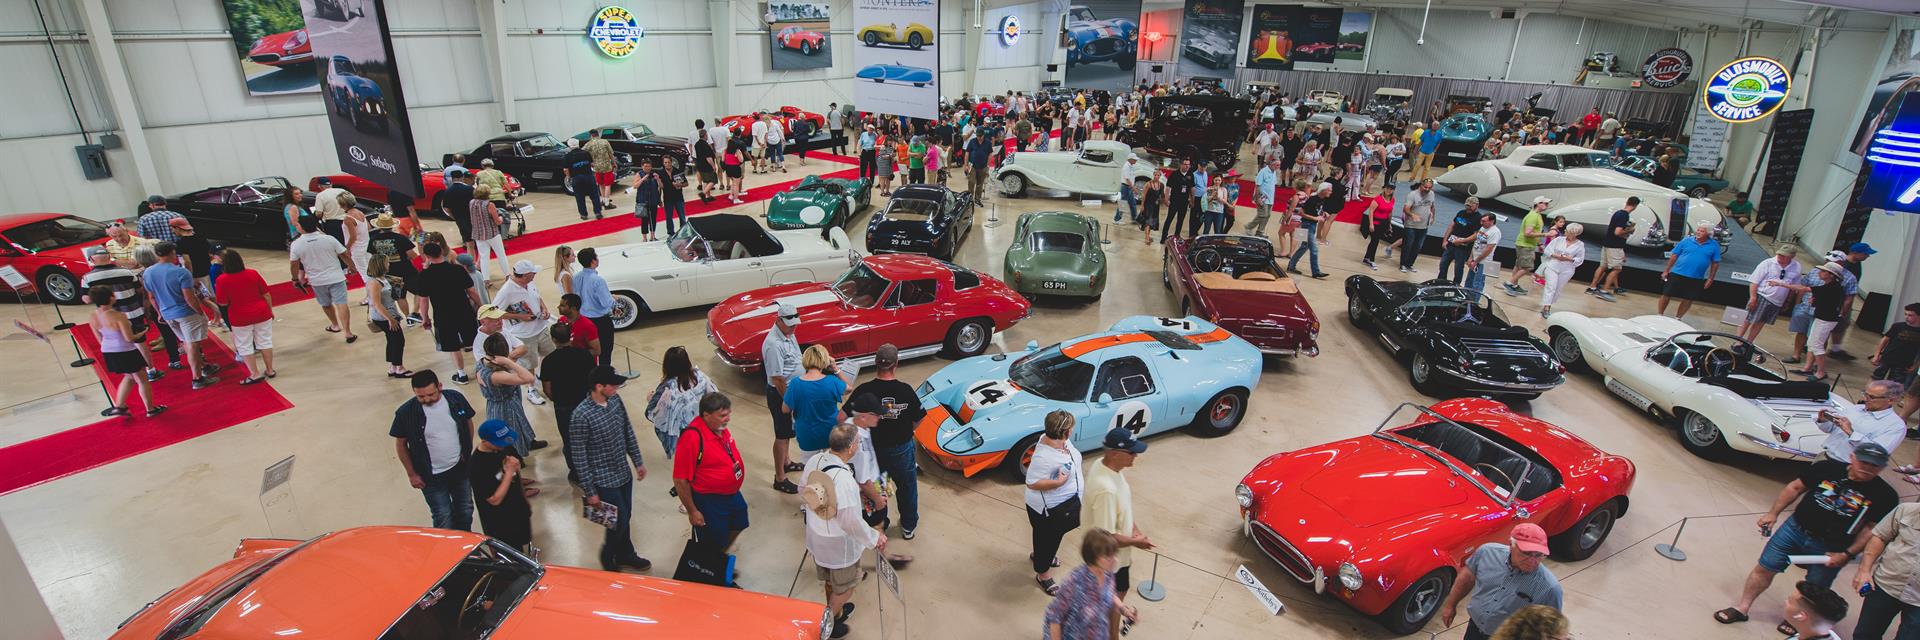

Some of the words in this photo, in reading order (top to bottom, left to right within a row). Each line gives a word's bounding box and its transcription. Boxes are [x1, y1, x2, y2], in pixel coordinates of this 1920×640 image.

[599, 8, 633, 22] SUPER
[594, 28, 640, 36] CHEVROLET
[599, 40, 637, 56] SERVICE
[1645, 60, 1688, 76] Buick
[1719, 61, 1786, 85] OLDSMOBILE
[1647, 77, 1679, 87] SERVICE
[1713, 102, 1762, 119] SERVICE
[969, 381, 1006, 405] 14
[1116, 409, 1147, 434] 14
